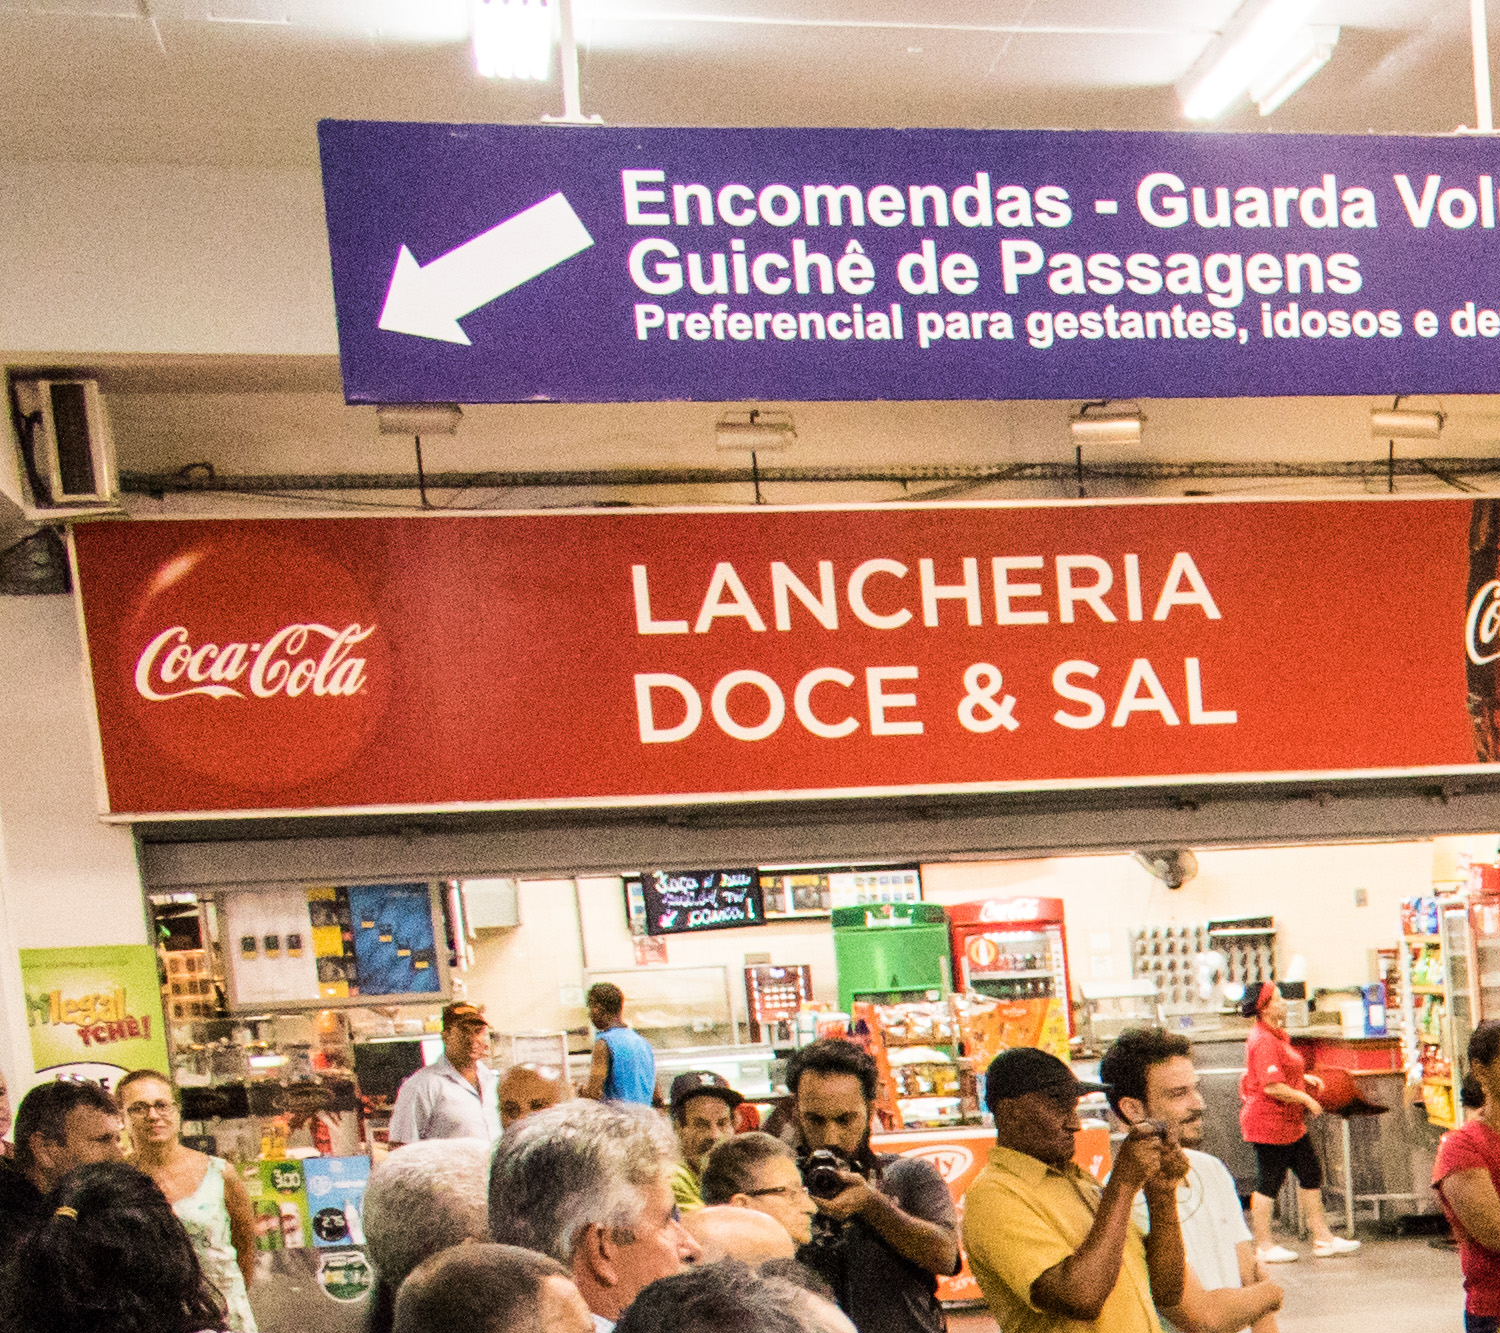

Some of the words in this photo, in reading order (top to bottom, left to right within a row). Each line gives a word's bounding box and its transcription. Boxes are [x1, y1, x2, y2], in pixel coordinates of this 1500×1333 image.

[620, 169, 1073, 228] Encomendas
[1138, 172, 1378, 229] Guarda
[628, 238, 876, 295] Guichê
[898, 239, 979, 295] de
[1001, 239, 1363, 308] Passagens
[634, 302, 903, 341] Preferencial
[917, 309, 1014, 348] para
[1026, 303, 1249, 349] gestantes,
[1261, 302, 1401, 339] idosos
[1413, 309, 1439, 338] e
[631, 551, 1222, 636] LANCHERIA
[134, 622, 376, 702] Coca-Cola
[633, 665, 924, 744] DOCE
[957, 661, 1021, 733] &
[1052, 656, 1239, 731] SAL
